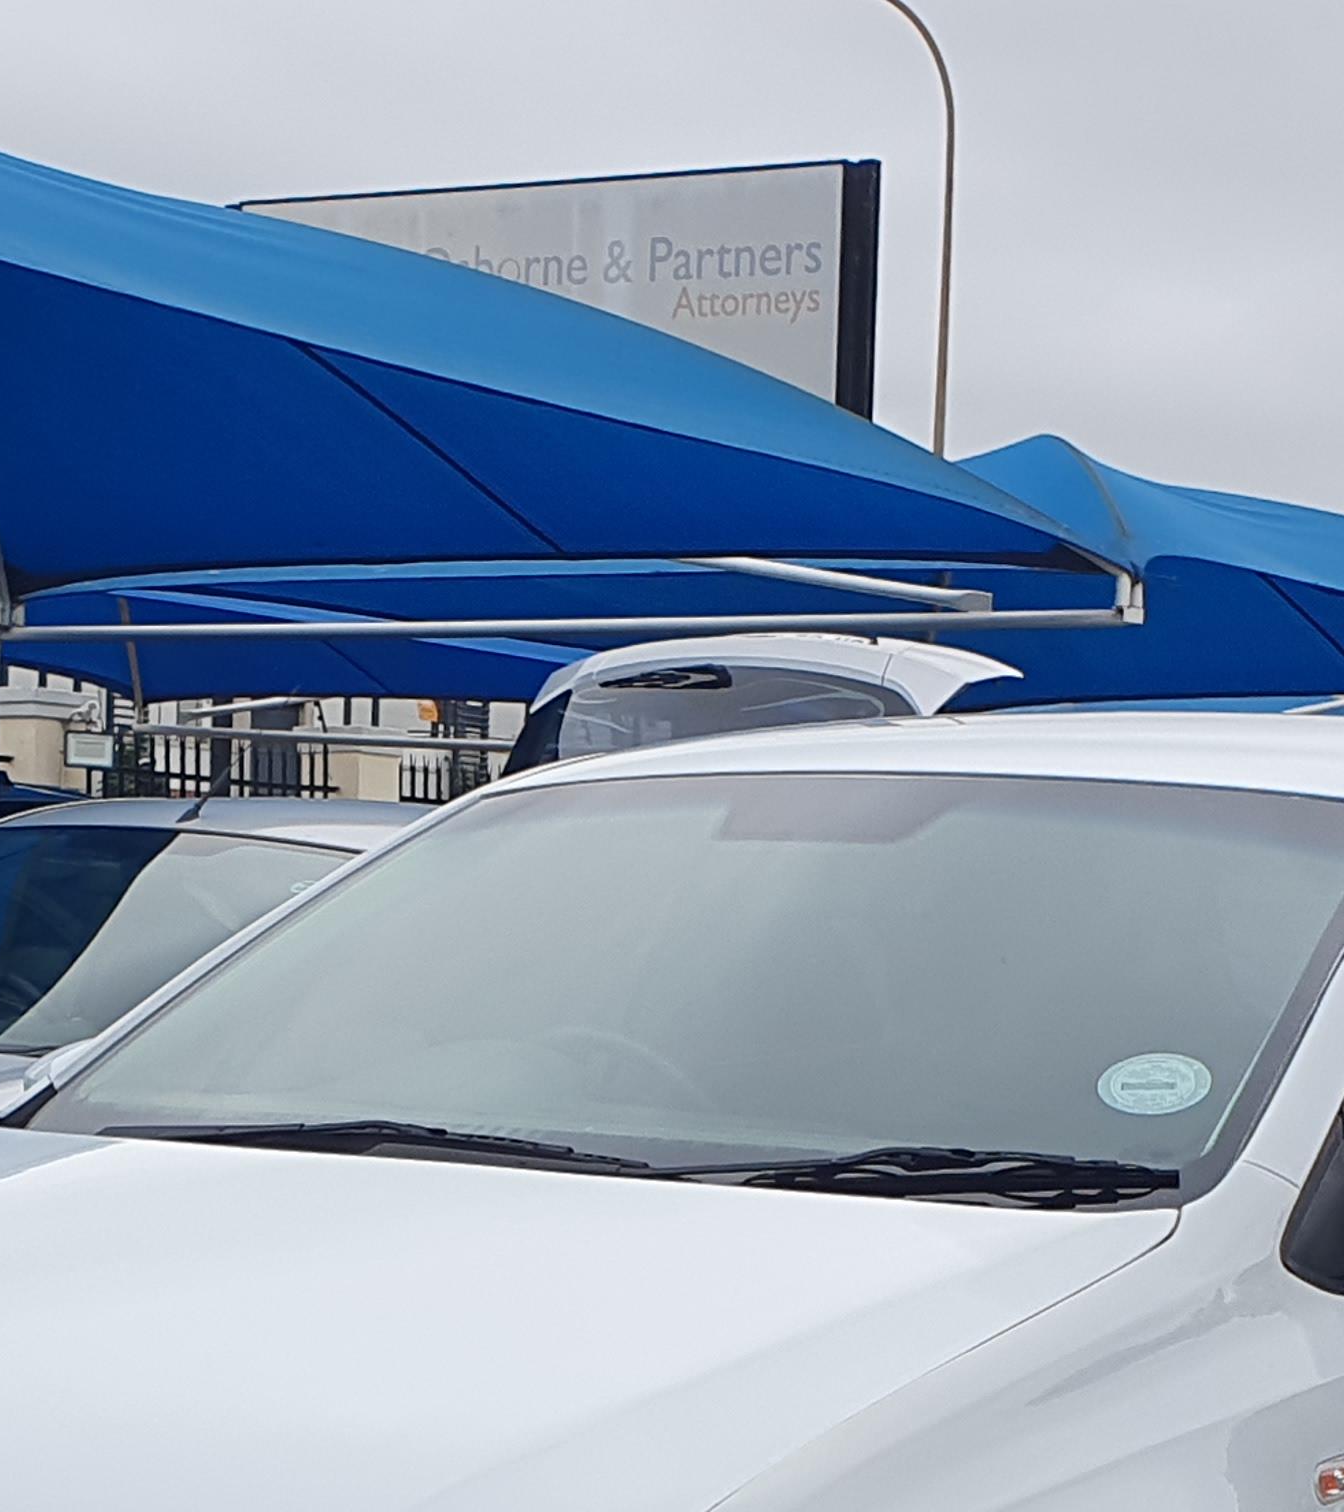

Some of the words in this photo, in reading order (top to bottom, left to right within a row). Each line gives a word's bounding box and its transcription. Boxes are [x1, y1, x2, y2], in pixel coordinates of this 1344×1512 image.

[603, 239, 632, 284] &
[649, 236, 823, 283] Partners
[672, 286, 821, 324] Attorneys
